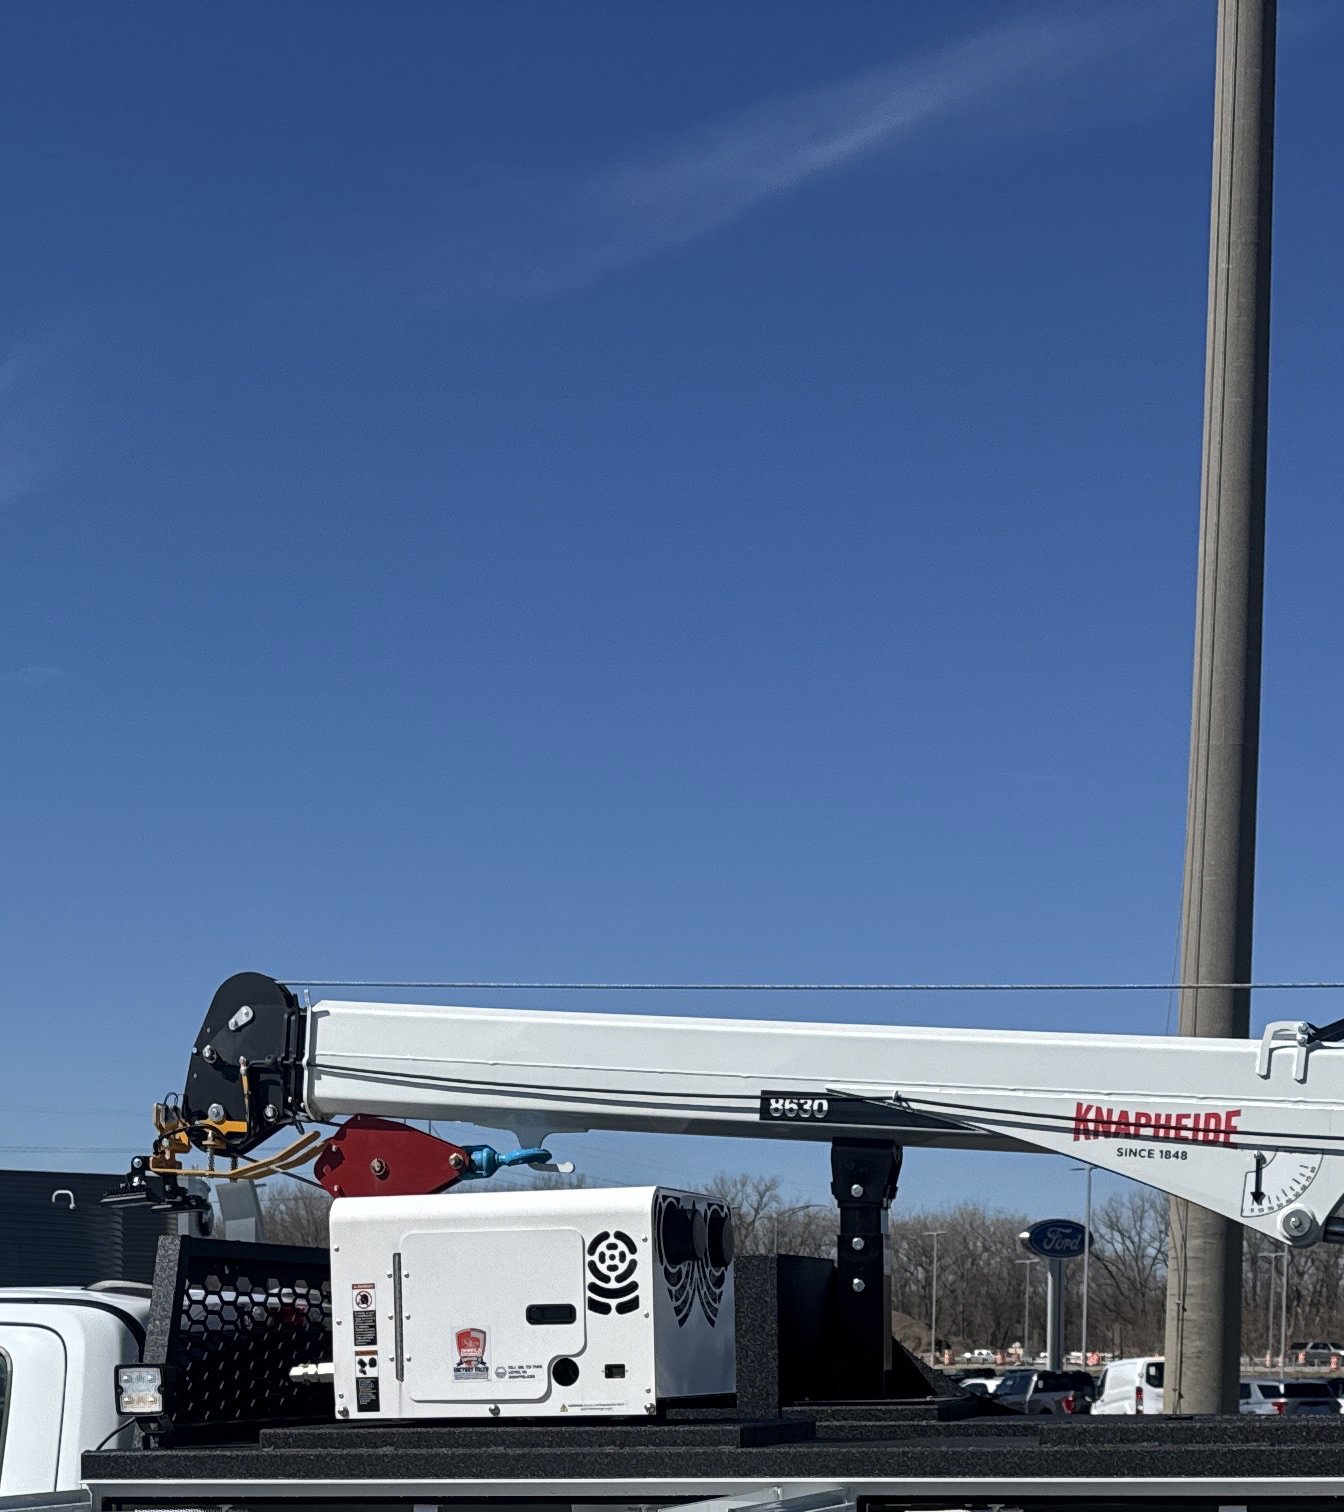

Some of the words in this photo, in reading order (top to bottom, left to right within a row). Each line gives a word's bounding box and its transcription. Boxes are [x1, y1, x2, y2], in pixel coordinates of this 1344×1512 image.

[769, 1098, 829, 1118] 8630
[1073, 1101, 1242, 1150] KNAPHEIDE
[1116, 1147, 1155, 1159] SINCE
[1159, 1149, 1188, 1160] 1848
[1042, 1227, 1082, 1250] Ford
